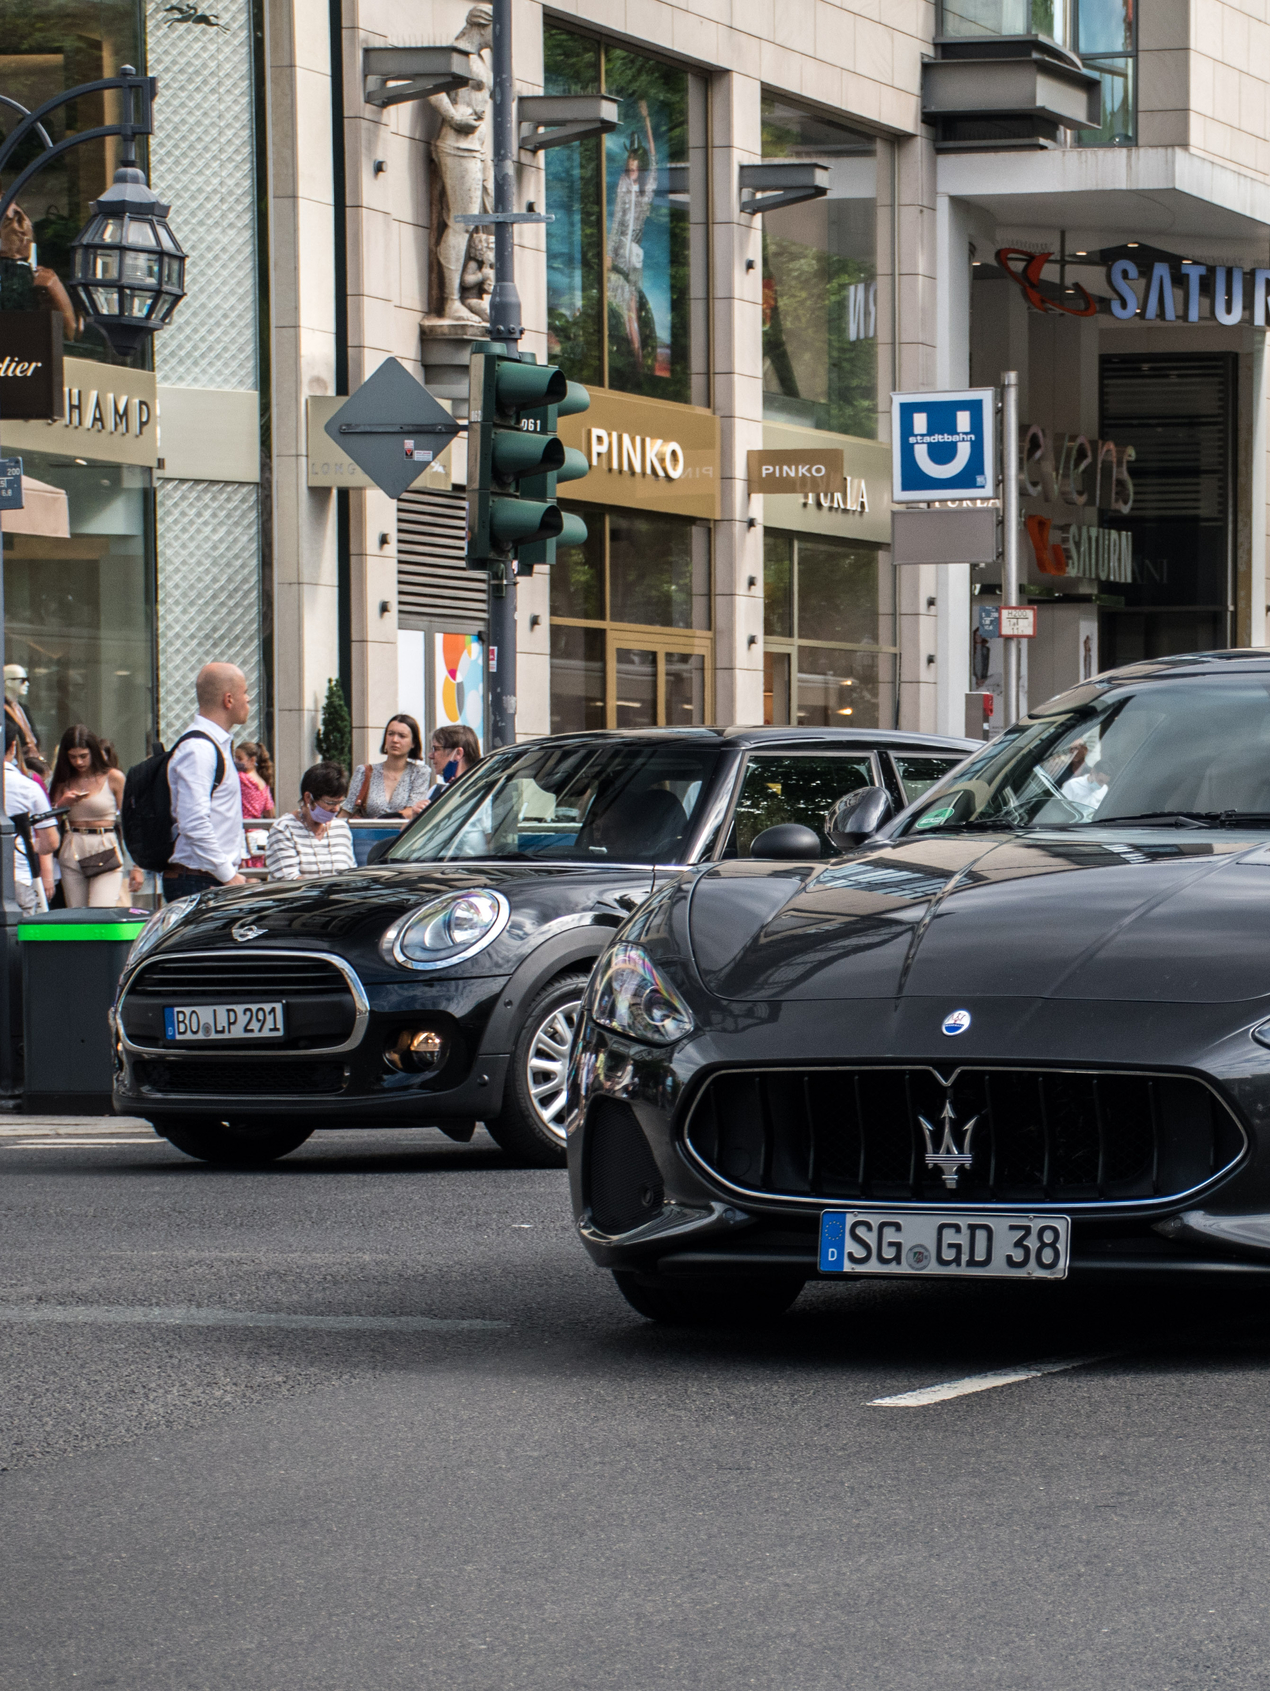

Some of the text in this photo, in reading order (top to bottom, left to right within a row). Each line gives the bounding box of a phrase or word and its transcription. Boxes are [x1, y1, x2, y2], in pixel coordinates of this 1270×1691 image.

[0, 356, 42, 377] tier
[62, 387, 150, 436] HAMP
[521, 419, 541, 431] 061
[908, 433, 975, 444] stadtbahn
[590, 427, 684, 479] PINKO
[311, 462, 367, 475] LONG
[761, 464, 826, 477] PINKO
[1067, 523, 1132, 583] SATURN
[176, 1010, 200, 1035] BO
[213, 1008, 238, 1034] LP
[243, 1006, 281, 1033] 291
[828, 1220, 1061, 1270] D SG GD 38
